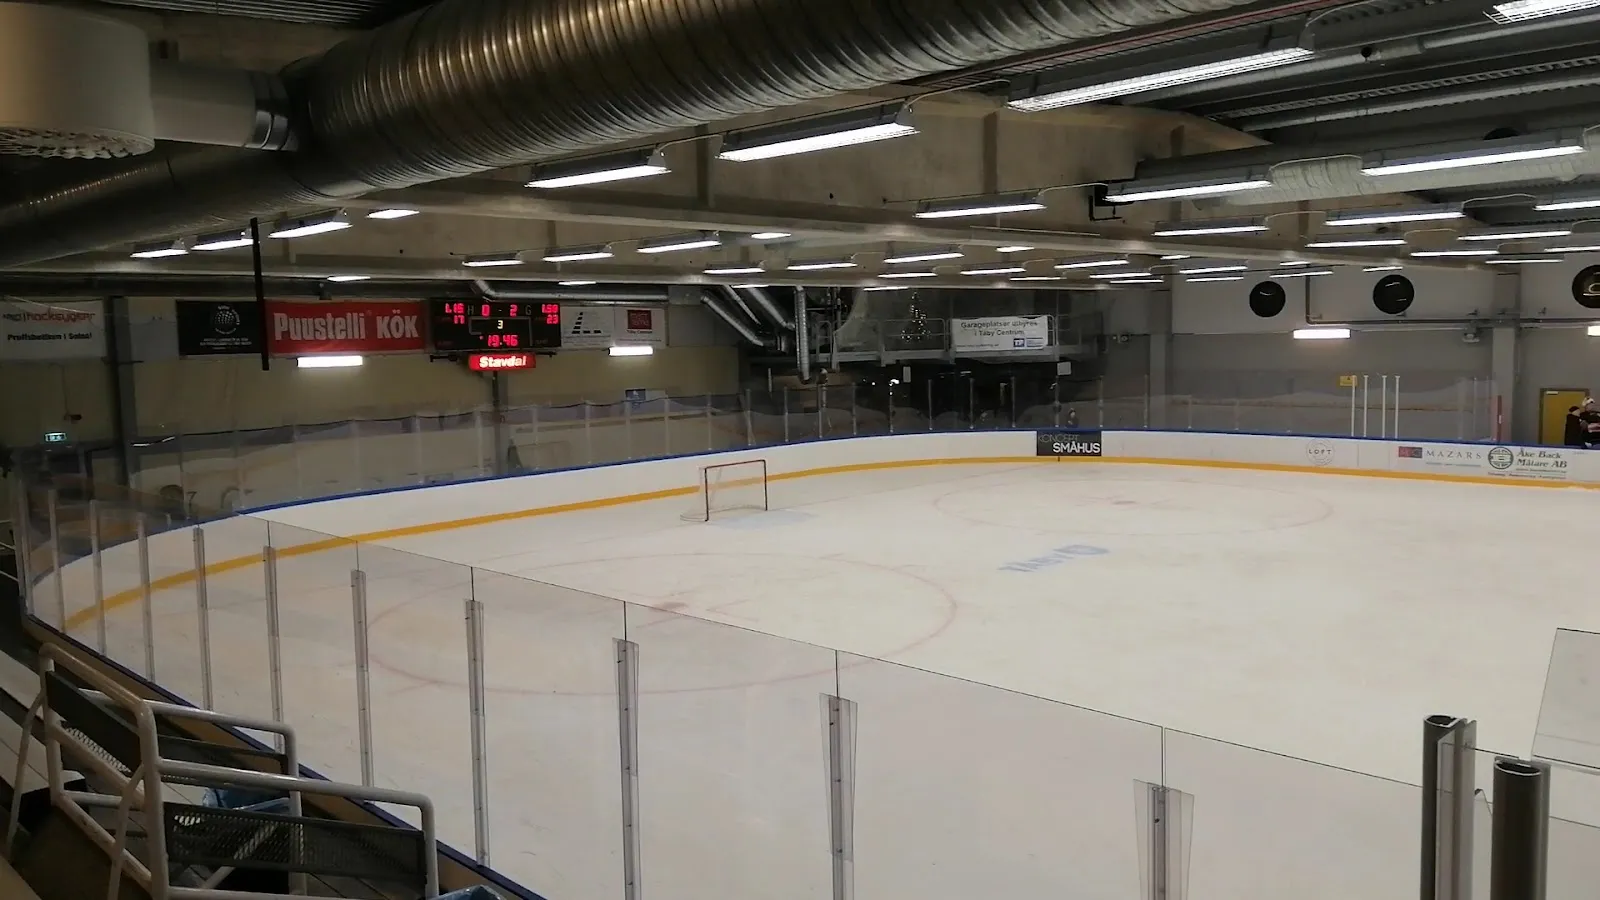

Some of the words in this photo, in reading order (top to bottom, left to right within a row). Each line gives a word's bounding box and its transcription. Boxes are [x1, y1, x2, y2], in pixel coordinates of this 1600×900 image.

[481, 303, 491, 317] 0
[509, 303, 519, 317] 2
[274, 312, 365, 340] Puustelli
[376, 309, 420, 339] KÖK
[453, 314, 466, 325] 17
[496, 319, 504, 330] 3
[546, 314, 560, 325] 23
[479, 355, 527, 368] Stavdal
[1052, 440, 1101, 454] SMÅHUS
[1426, 449, 1482, 460] MAZARS
[1538, 450, 1562, 459] Back
[1551, 460, 1568, 469] AB
